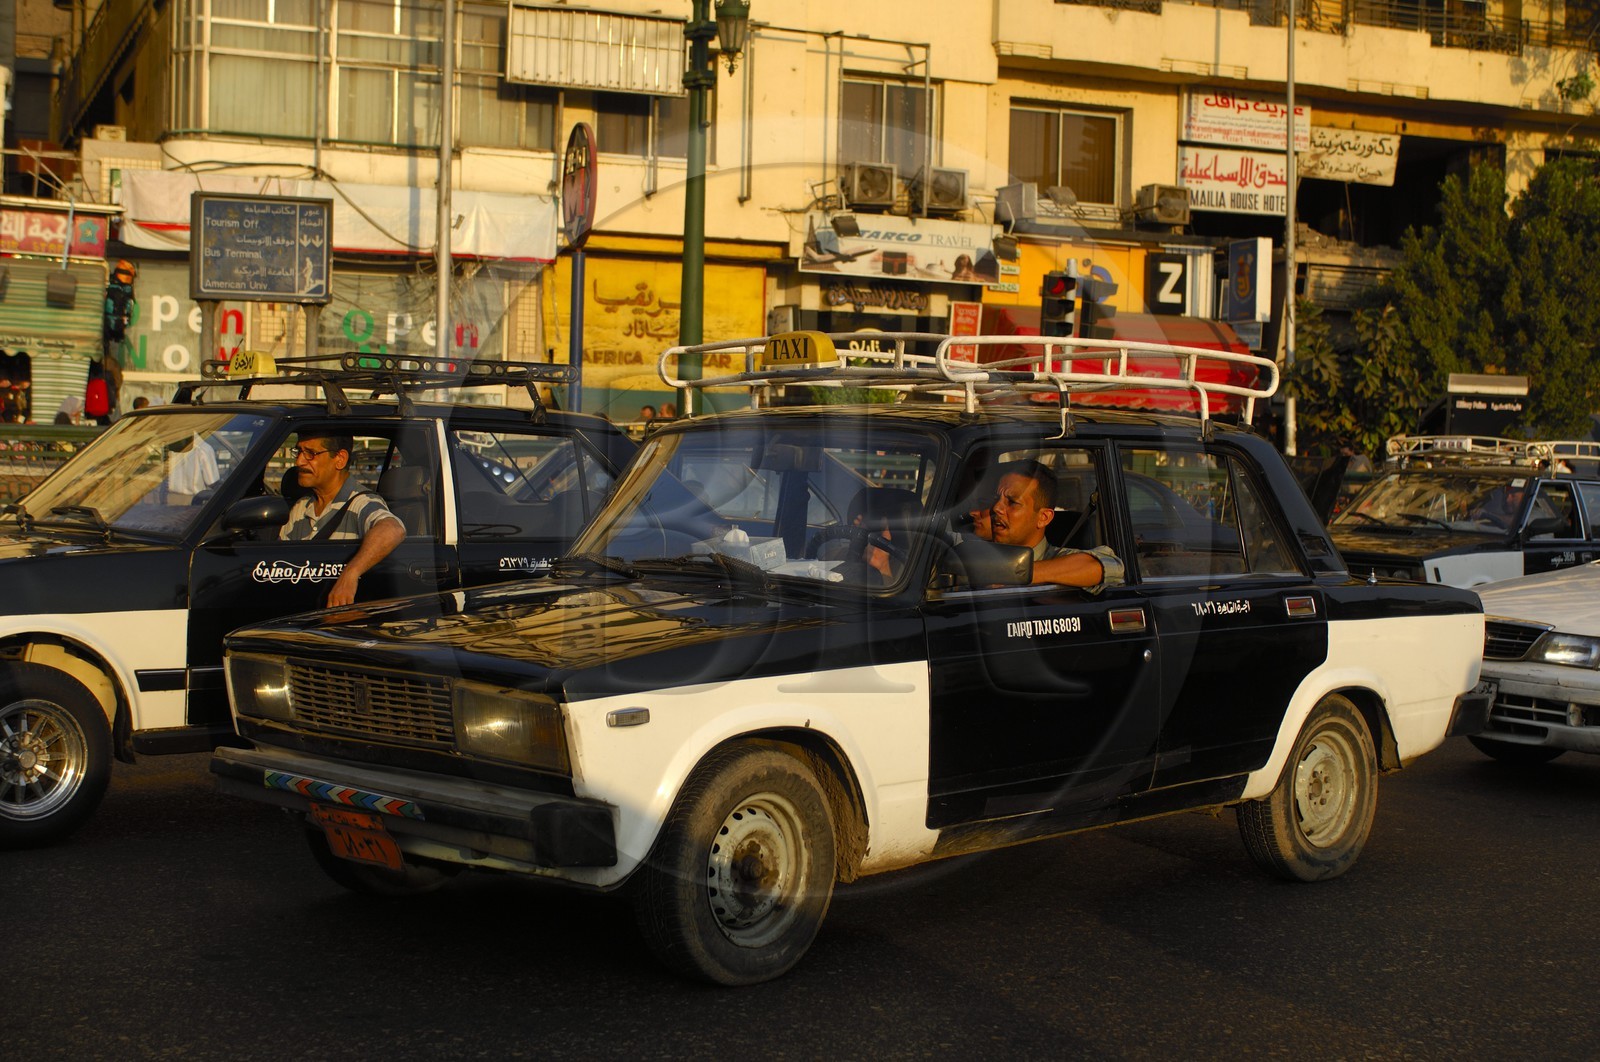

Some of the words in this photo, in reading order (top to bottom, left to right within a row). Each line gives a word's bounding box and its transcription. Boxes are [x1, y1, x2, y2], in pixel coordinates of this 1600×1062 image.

[1253, 163, 1287, 189] ندق
[1189, 190, 1226, 208] MAILIA
[1230, 192, 1259, 211] HOUSE
[1263, 194, 1287, 213] HOTE
[205, 217, 240, 228] Tourism
[858, 229, 922, 243] TARCO
[928, 233, 976, 248] TRAVEL
[205, 247, 221, 257] Bus
[225, 249, 262, 259] Terminal
[205, 279, 247, 289] American
[1159, 262, 1183, 304] Z
[130, 293, 244, 336] pen
[769, 338, 808, 360] TAXI
[581, 350, 644, 366] AFRICA
[671, 352, 732, 369] ZAR
[499, 557, 529, 569] ٥٦٣٧٩
[1191, 600, 1217, 616] ٦٨٠٣١
[1007, 620, 1033, 639] CAIRO
[1032, 619, 1053, 636] TAXI
[1053, 617, 1081, 635] 68031
